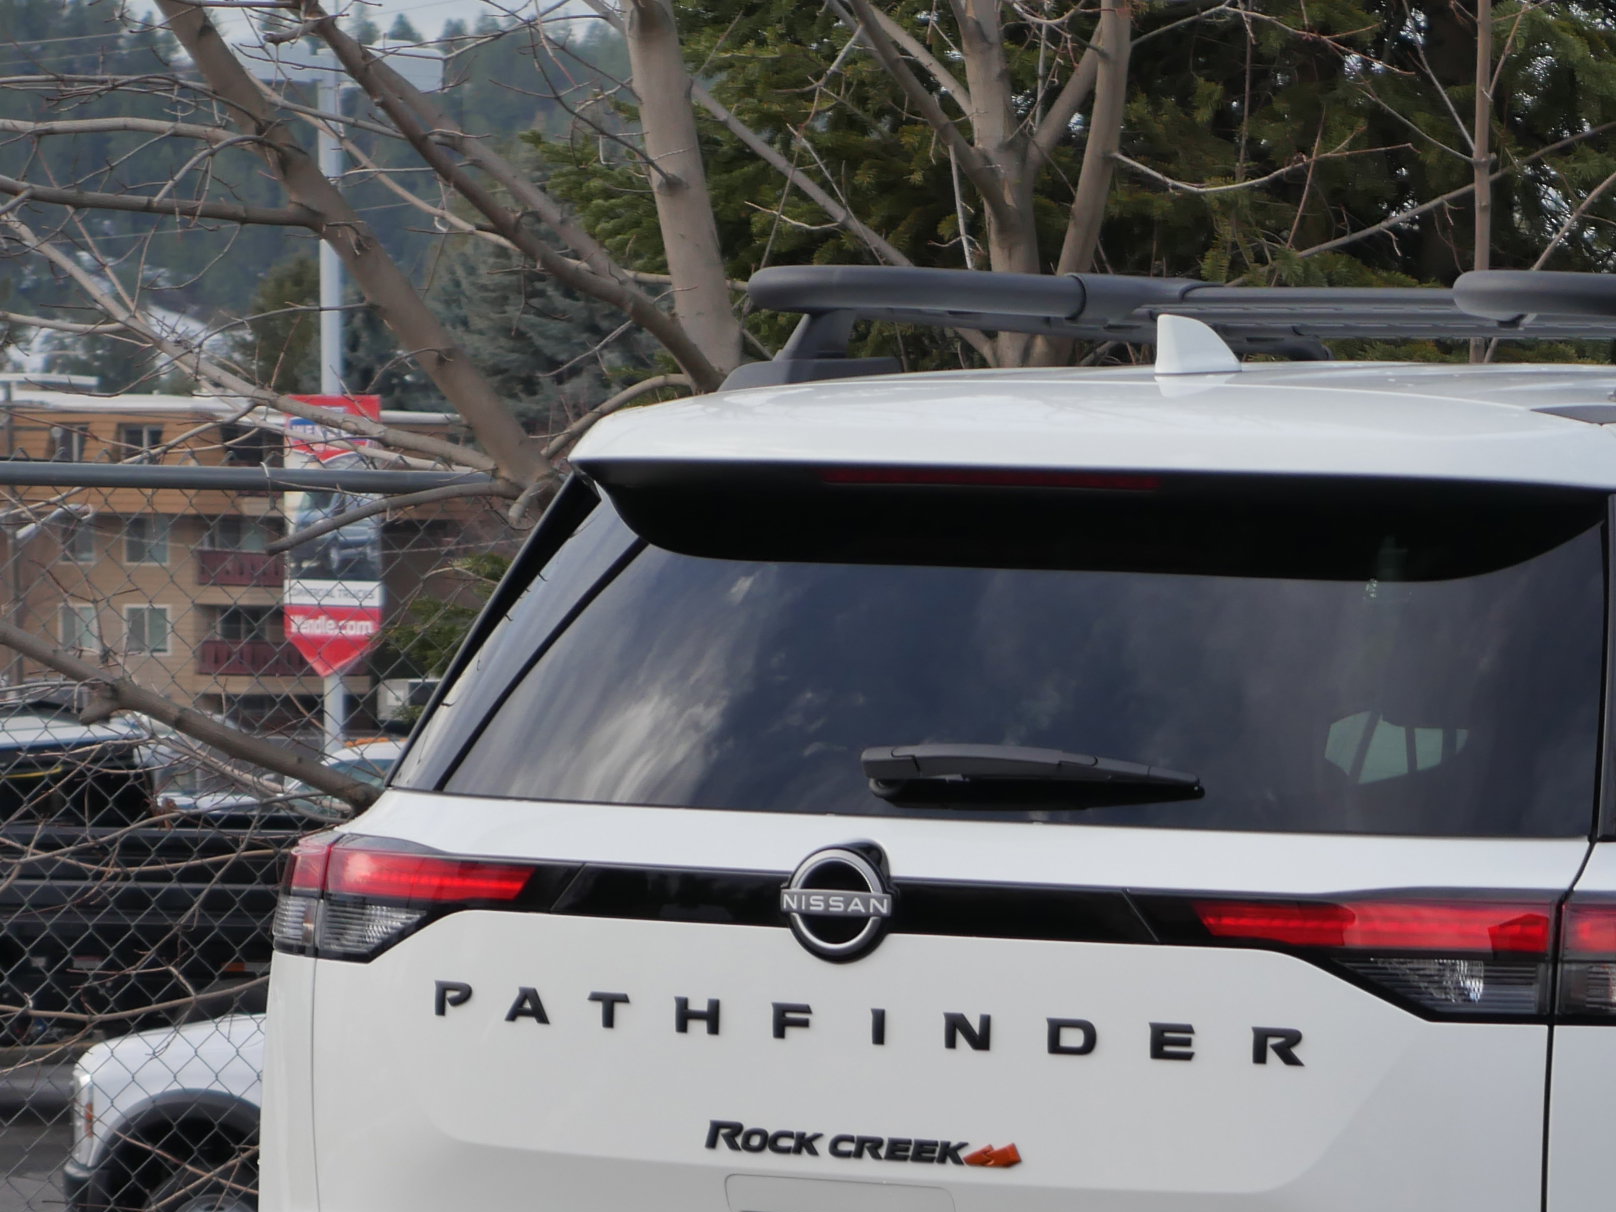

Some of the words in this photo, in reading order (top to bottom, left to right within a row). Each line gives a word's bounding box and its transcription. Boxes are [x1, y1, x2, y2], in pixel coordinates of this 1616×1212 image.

[782, 892, 889, 915] NISSAN
[434, 979, 1305, 1067] PATHFINDER
[705, 1119, 822, 1157] ROCK
[828, 1133, 970, 1166] CREEK
